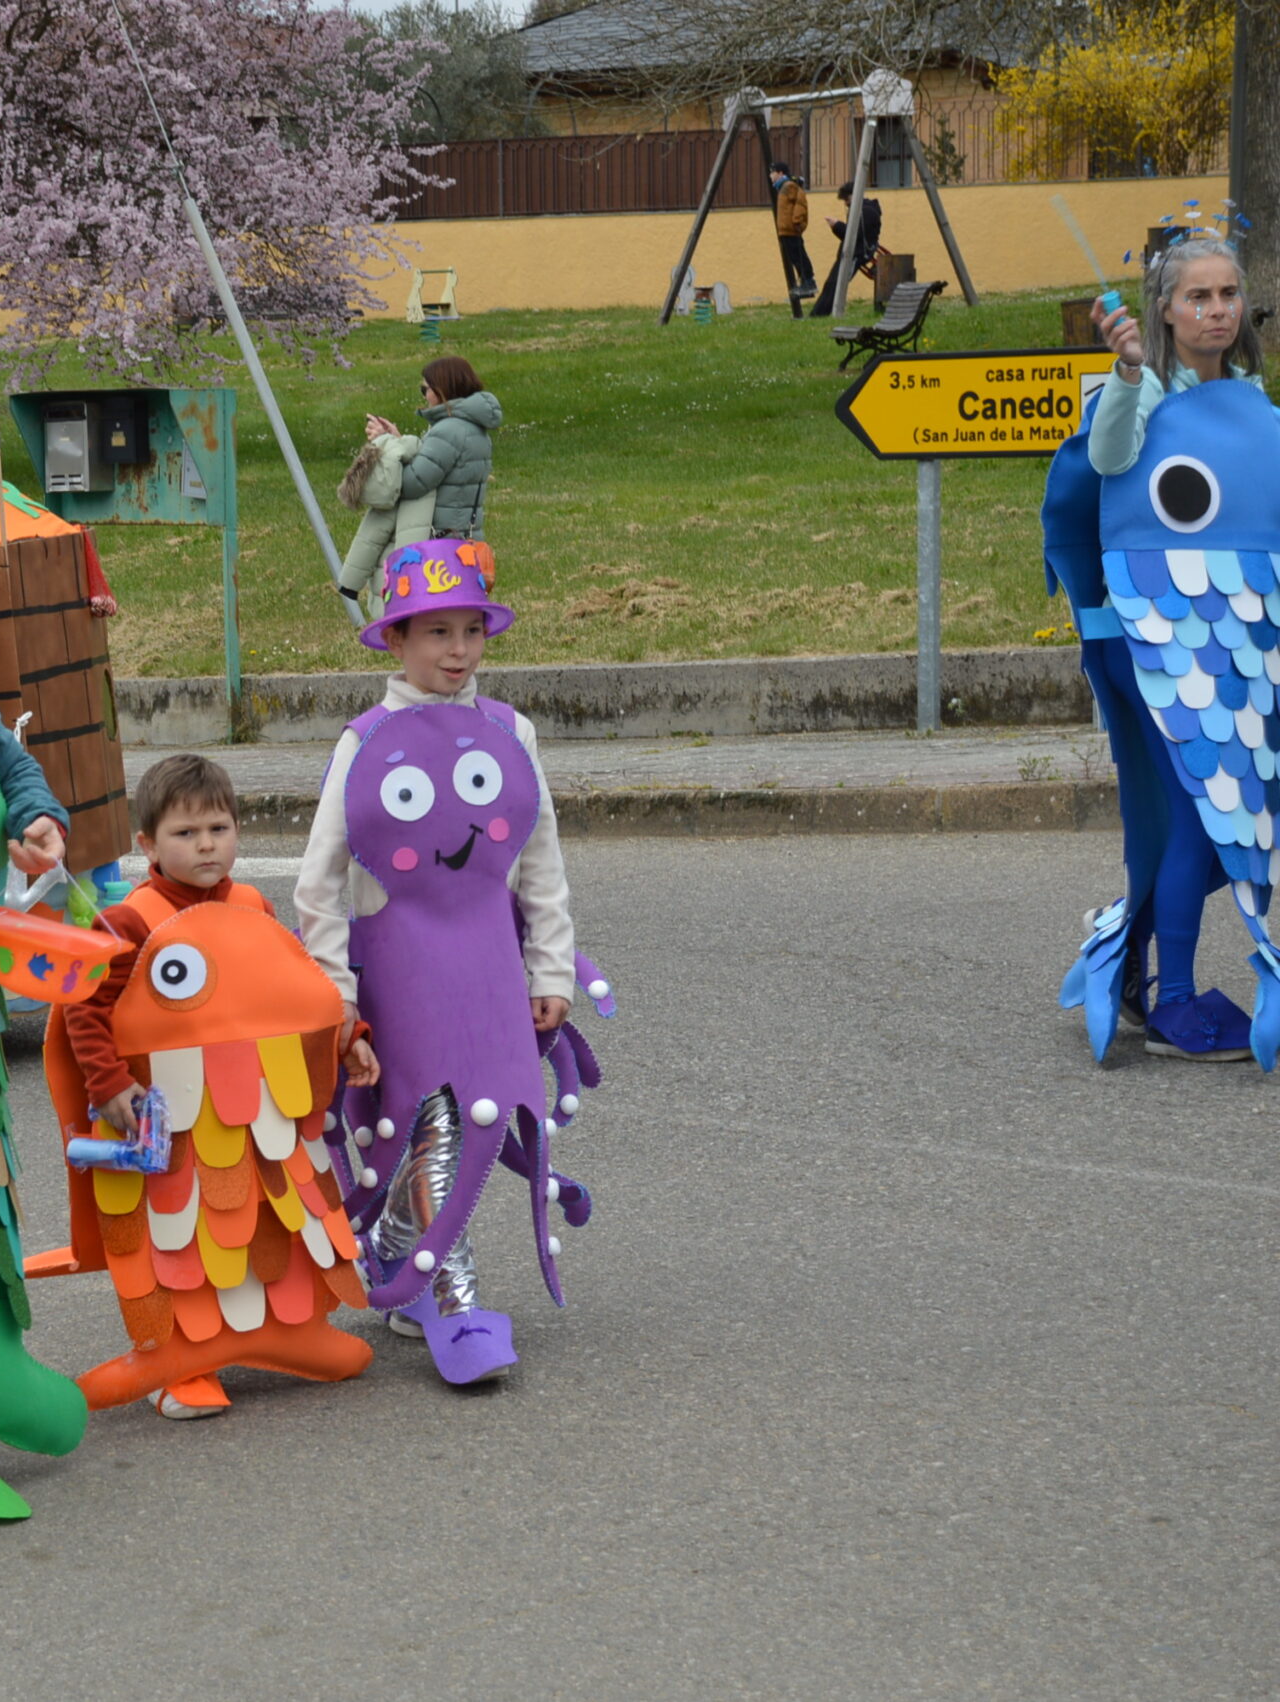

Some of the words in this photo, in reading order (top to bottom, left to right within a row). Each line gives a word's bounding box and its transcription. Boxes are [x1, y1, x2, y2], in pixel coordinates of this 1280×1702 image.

[889, 371, 916, 391] 3,5
[920, 374, 941, 389] km
[986, 367, 1025, 383] casa
[1031, 362, 1074, 381] rural
[958, 389, 1074, 422] Canedo
[953, 427, 985, 442] Juan
[990, 427, 1007, 442] de
[1011, 426, 1024, 441] la
[1029, 424, 1074, 441] Mata)
